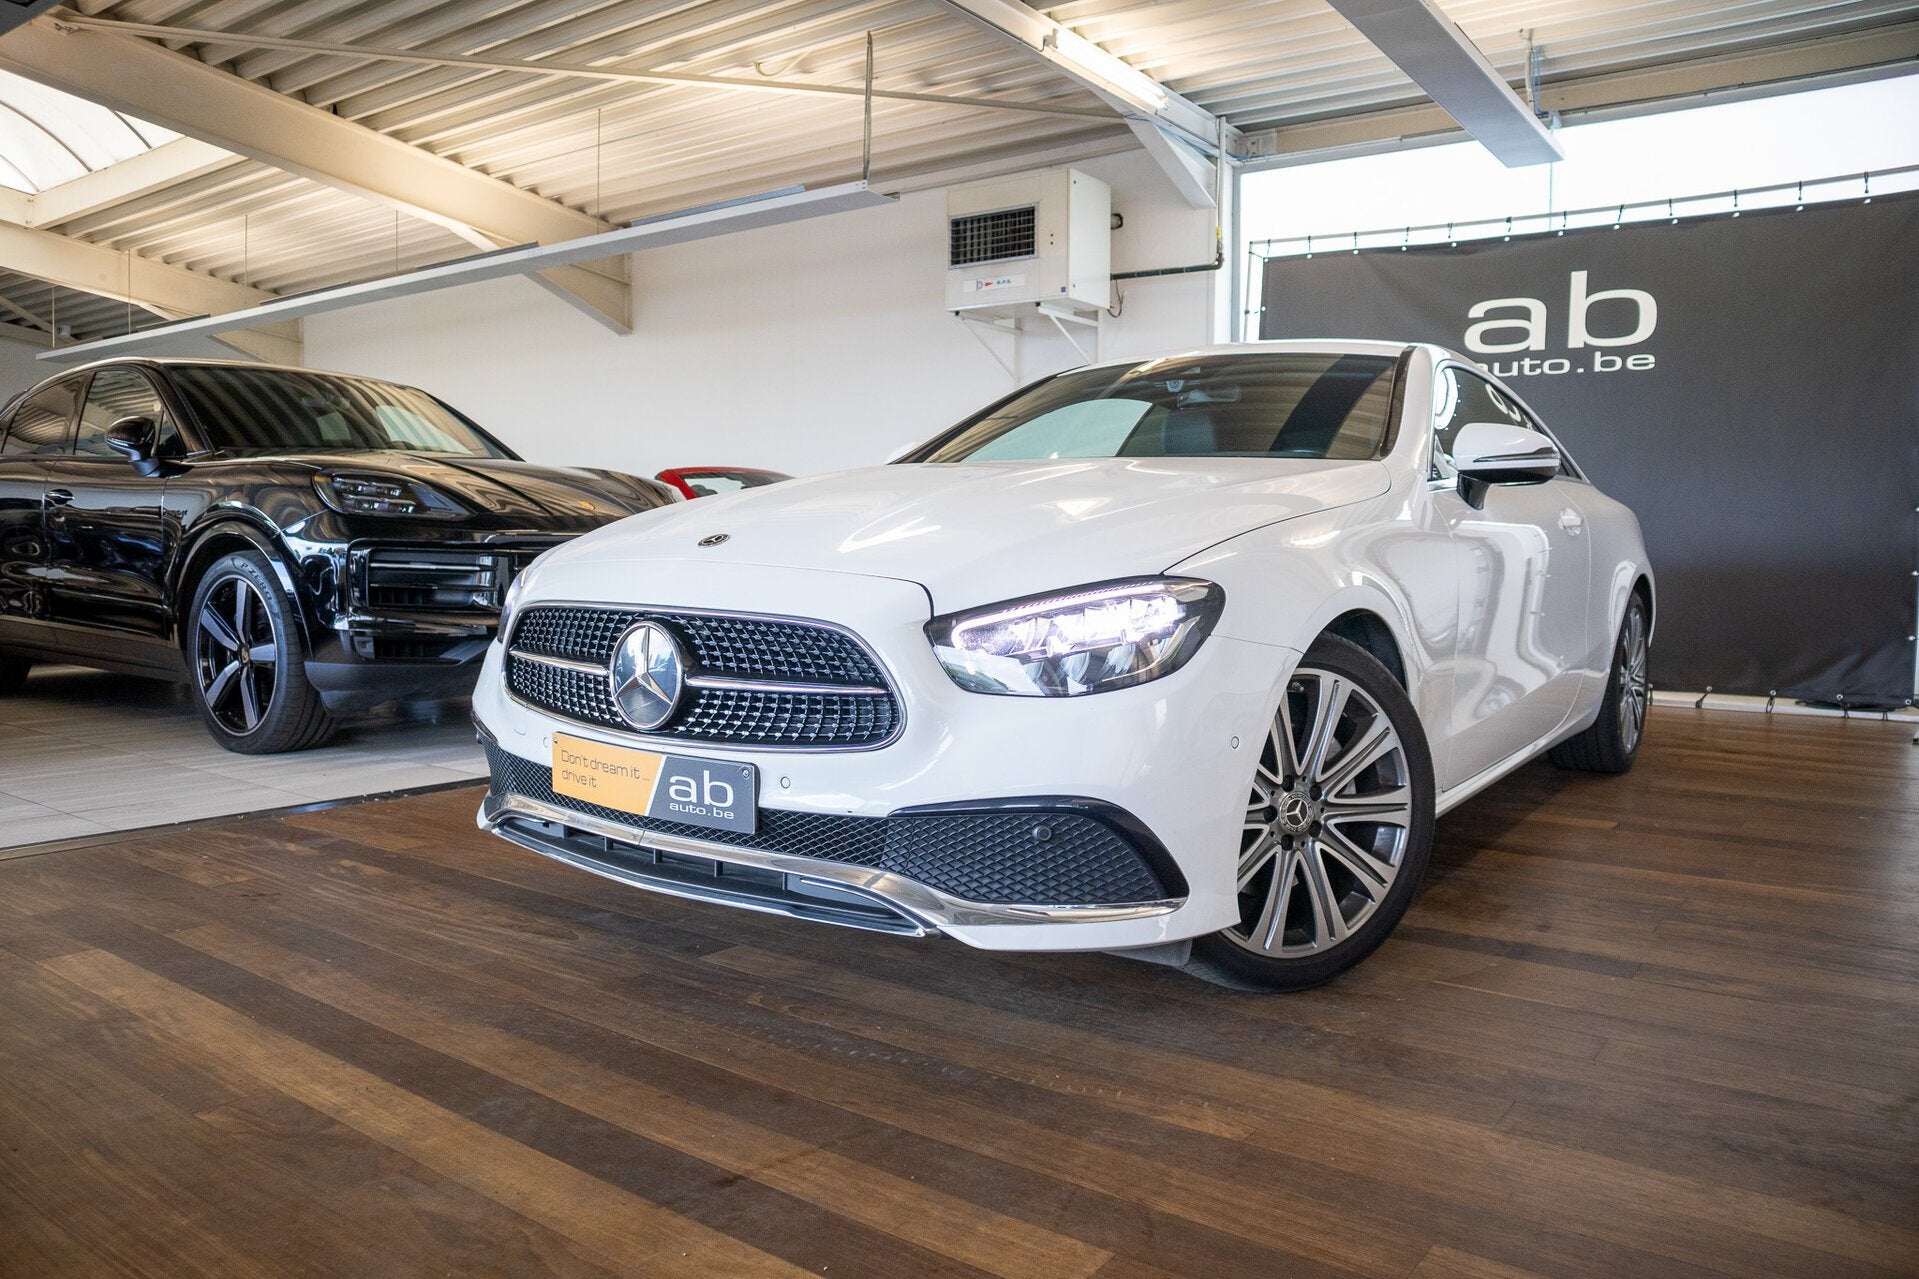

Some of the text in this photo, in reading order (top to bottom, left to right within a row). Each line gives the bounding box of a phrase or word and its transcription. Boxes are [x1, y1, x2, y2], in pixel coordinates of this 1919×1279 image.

[1463, 269, 1658, 354] ab
[560, 749, 589, 768] Don't
[589, 758, 629, 777] dream
[629, 765, 641, 780] it
[561, 768, 598, 788] drive it
[669, 769, 734, 808] ab
[669, 802, 735, 820] auto.be
